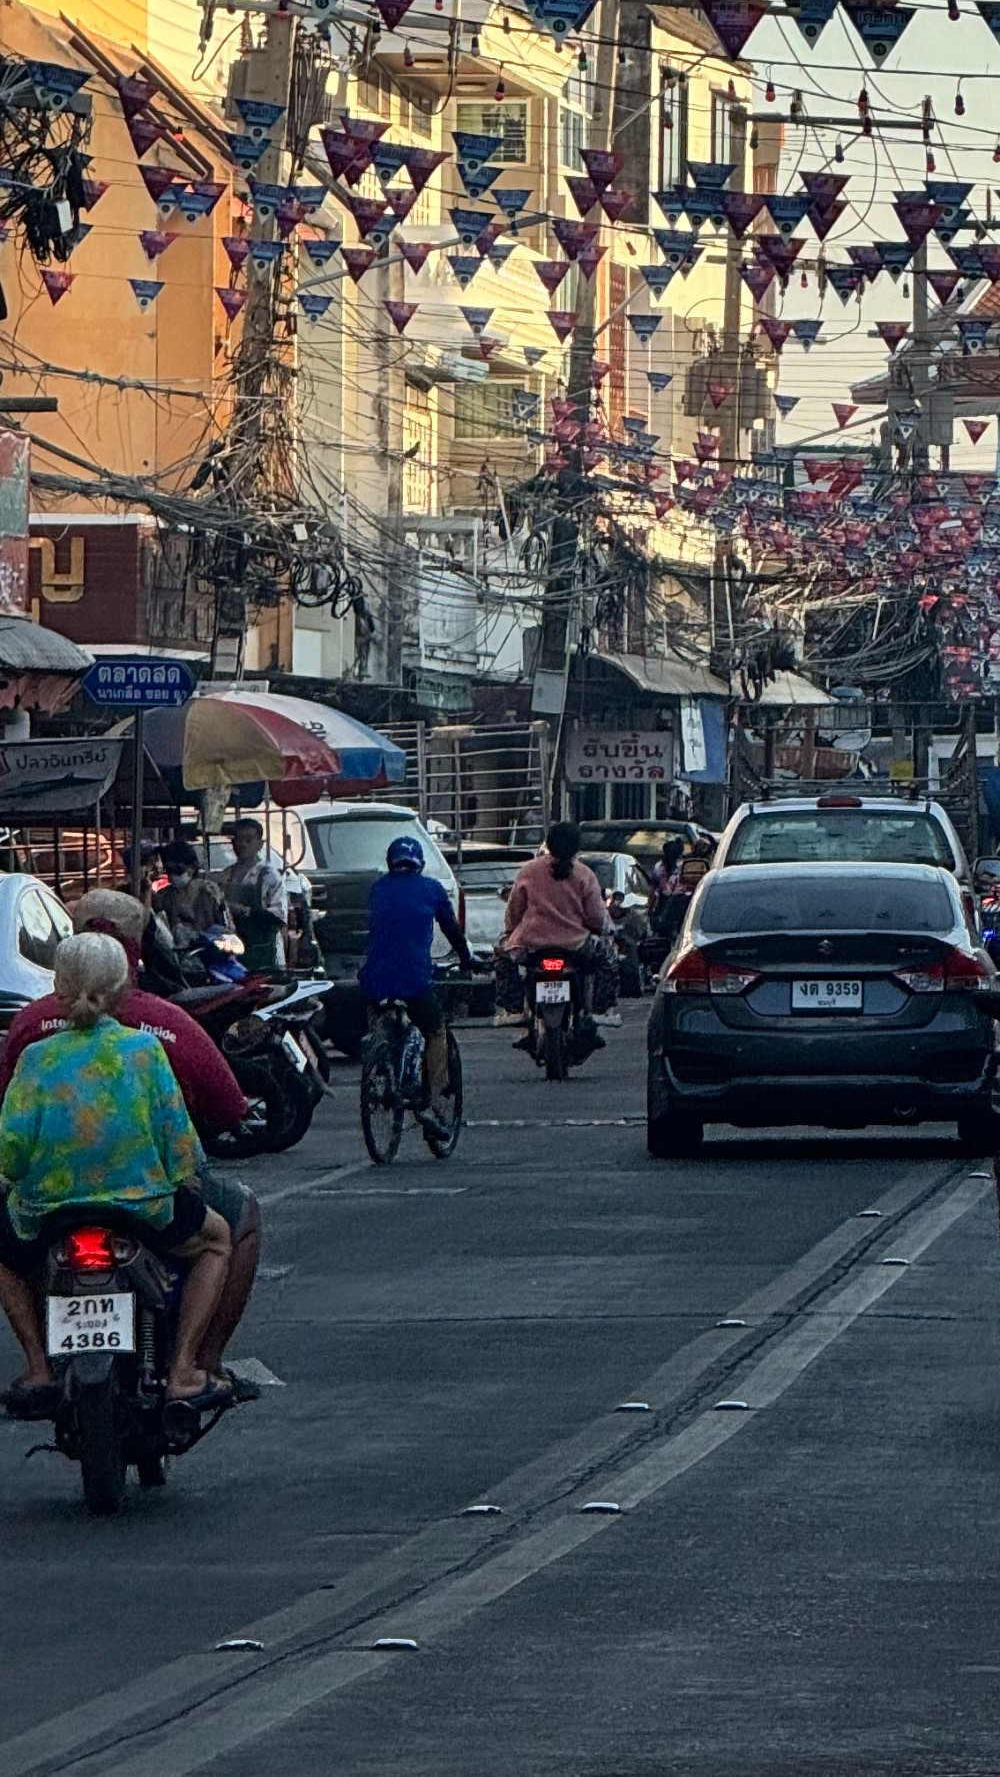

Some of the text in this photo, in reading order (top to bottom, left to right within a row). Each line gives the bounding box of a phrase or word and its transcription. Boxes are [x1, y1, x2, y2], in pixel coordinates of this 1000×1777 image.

[98, 666, 180, 684] ตลาดสด
[97, 685, 142, 700] นาเกลือ
[145, 689, 169, 700] ซอย
[583, 733, 664, 758] รับขึ้น
[578, 759, 665, 779] รางวัล
[826, 983, 860, 996] 9359
[141, 1021, 177, 1043] Inside
[67, 1298, 114, 1317] 2กท
[61, 1331, 120, 1350] 4386
